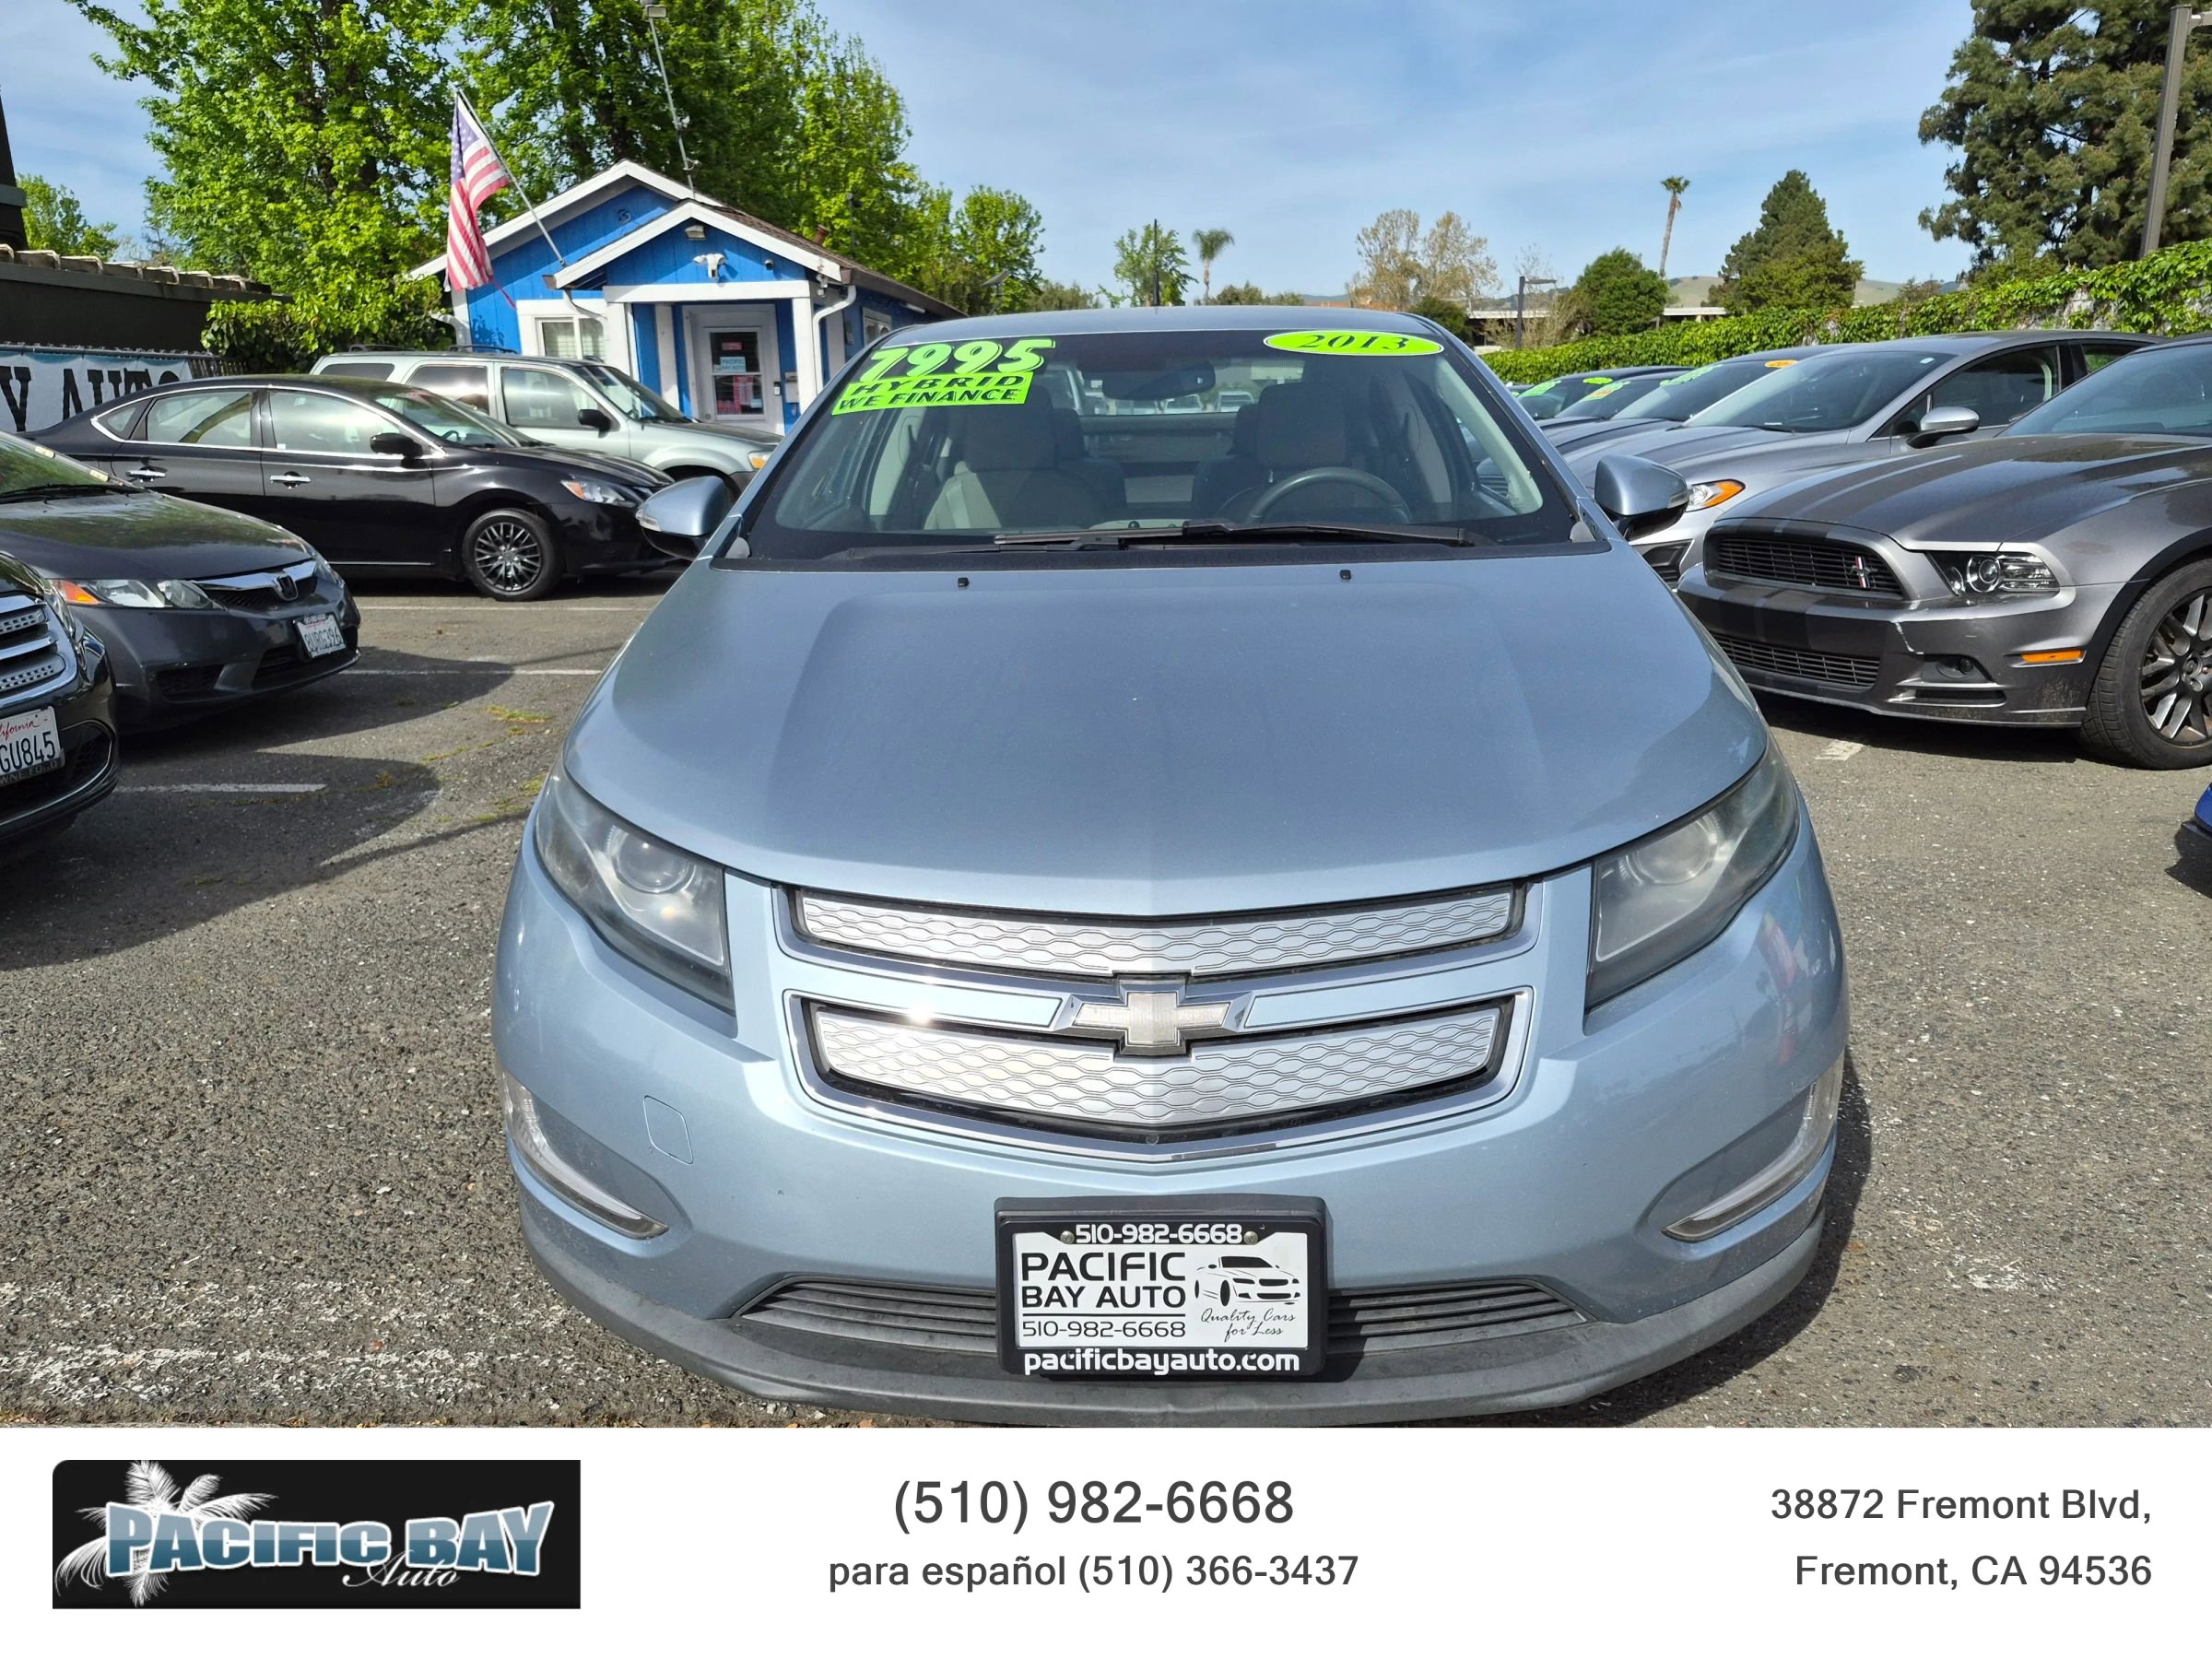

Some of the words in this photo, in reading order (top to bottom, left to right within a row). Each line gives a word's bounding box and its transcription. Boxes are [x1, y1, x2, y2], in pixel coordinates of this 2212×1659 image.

[1298, 335, 1410, 350] 2013
[859, 338, 1056, 382] 7995
[850, 374, 1026, 396] HYBRID
[839, 394, 885, 410] WE
[888, 387, 1021, 406] FINANCE
[1076, 1224, 1243, 1244] 510-982-6668
[1021, 1252, 1186, 1282] PACIFIC
[1021, 1286, 1088, 1309] BAY
[1095, 1286, 1186, 1309] AUTO
[1022, 1321, 1186, 1338] 510-982-6668
[1201, 1307, 1257, 1330] Quality
[1263, 1307, 1297, 1322] Cars
[1223, 1323, 1247, 1343] for
[1251, 1321, 1284, 1336] Less
[1023, 1347, 1300, 1376] pacificbayauto.com
